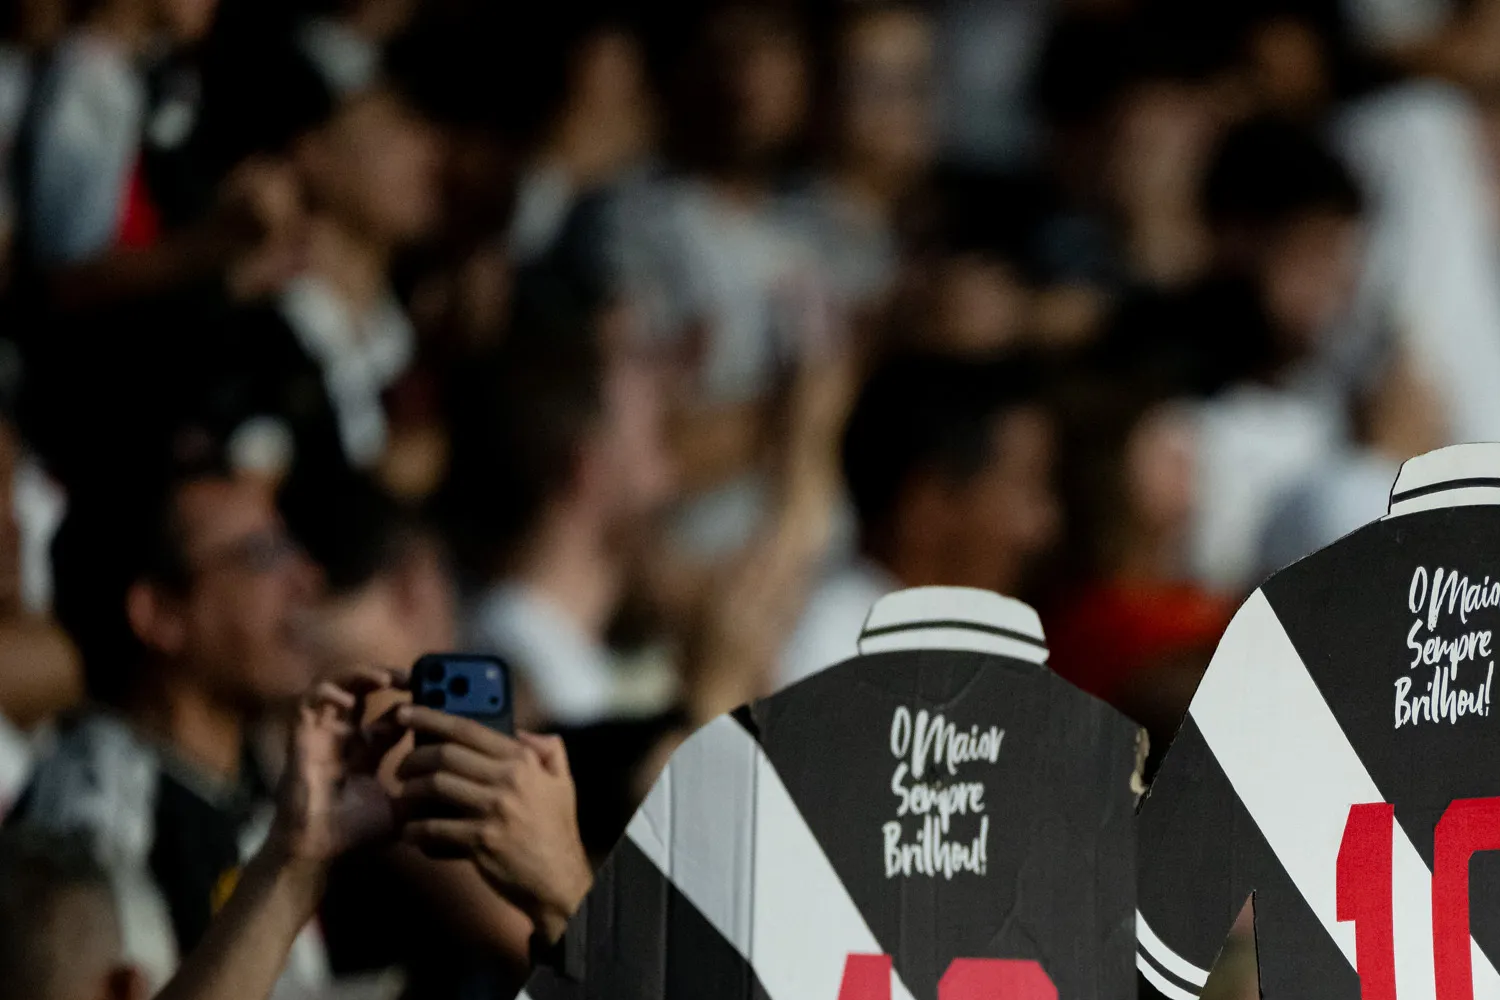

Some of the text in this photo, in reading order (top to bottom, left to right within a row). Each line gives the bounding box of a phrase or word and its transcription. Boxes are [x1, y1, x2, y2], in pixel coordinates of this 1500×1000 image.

[1408, 566, 1428, 613] O
[1406, 618, 1492, 681] Sempre
[1394, 660, 1494, 729] Brilhou!
[890, 706, 1005, 779] O Maior
[891, 762, 985, 834] Sempre
[882, 814, 989, 880] Brilhou!
